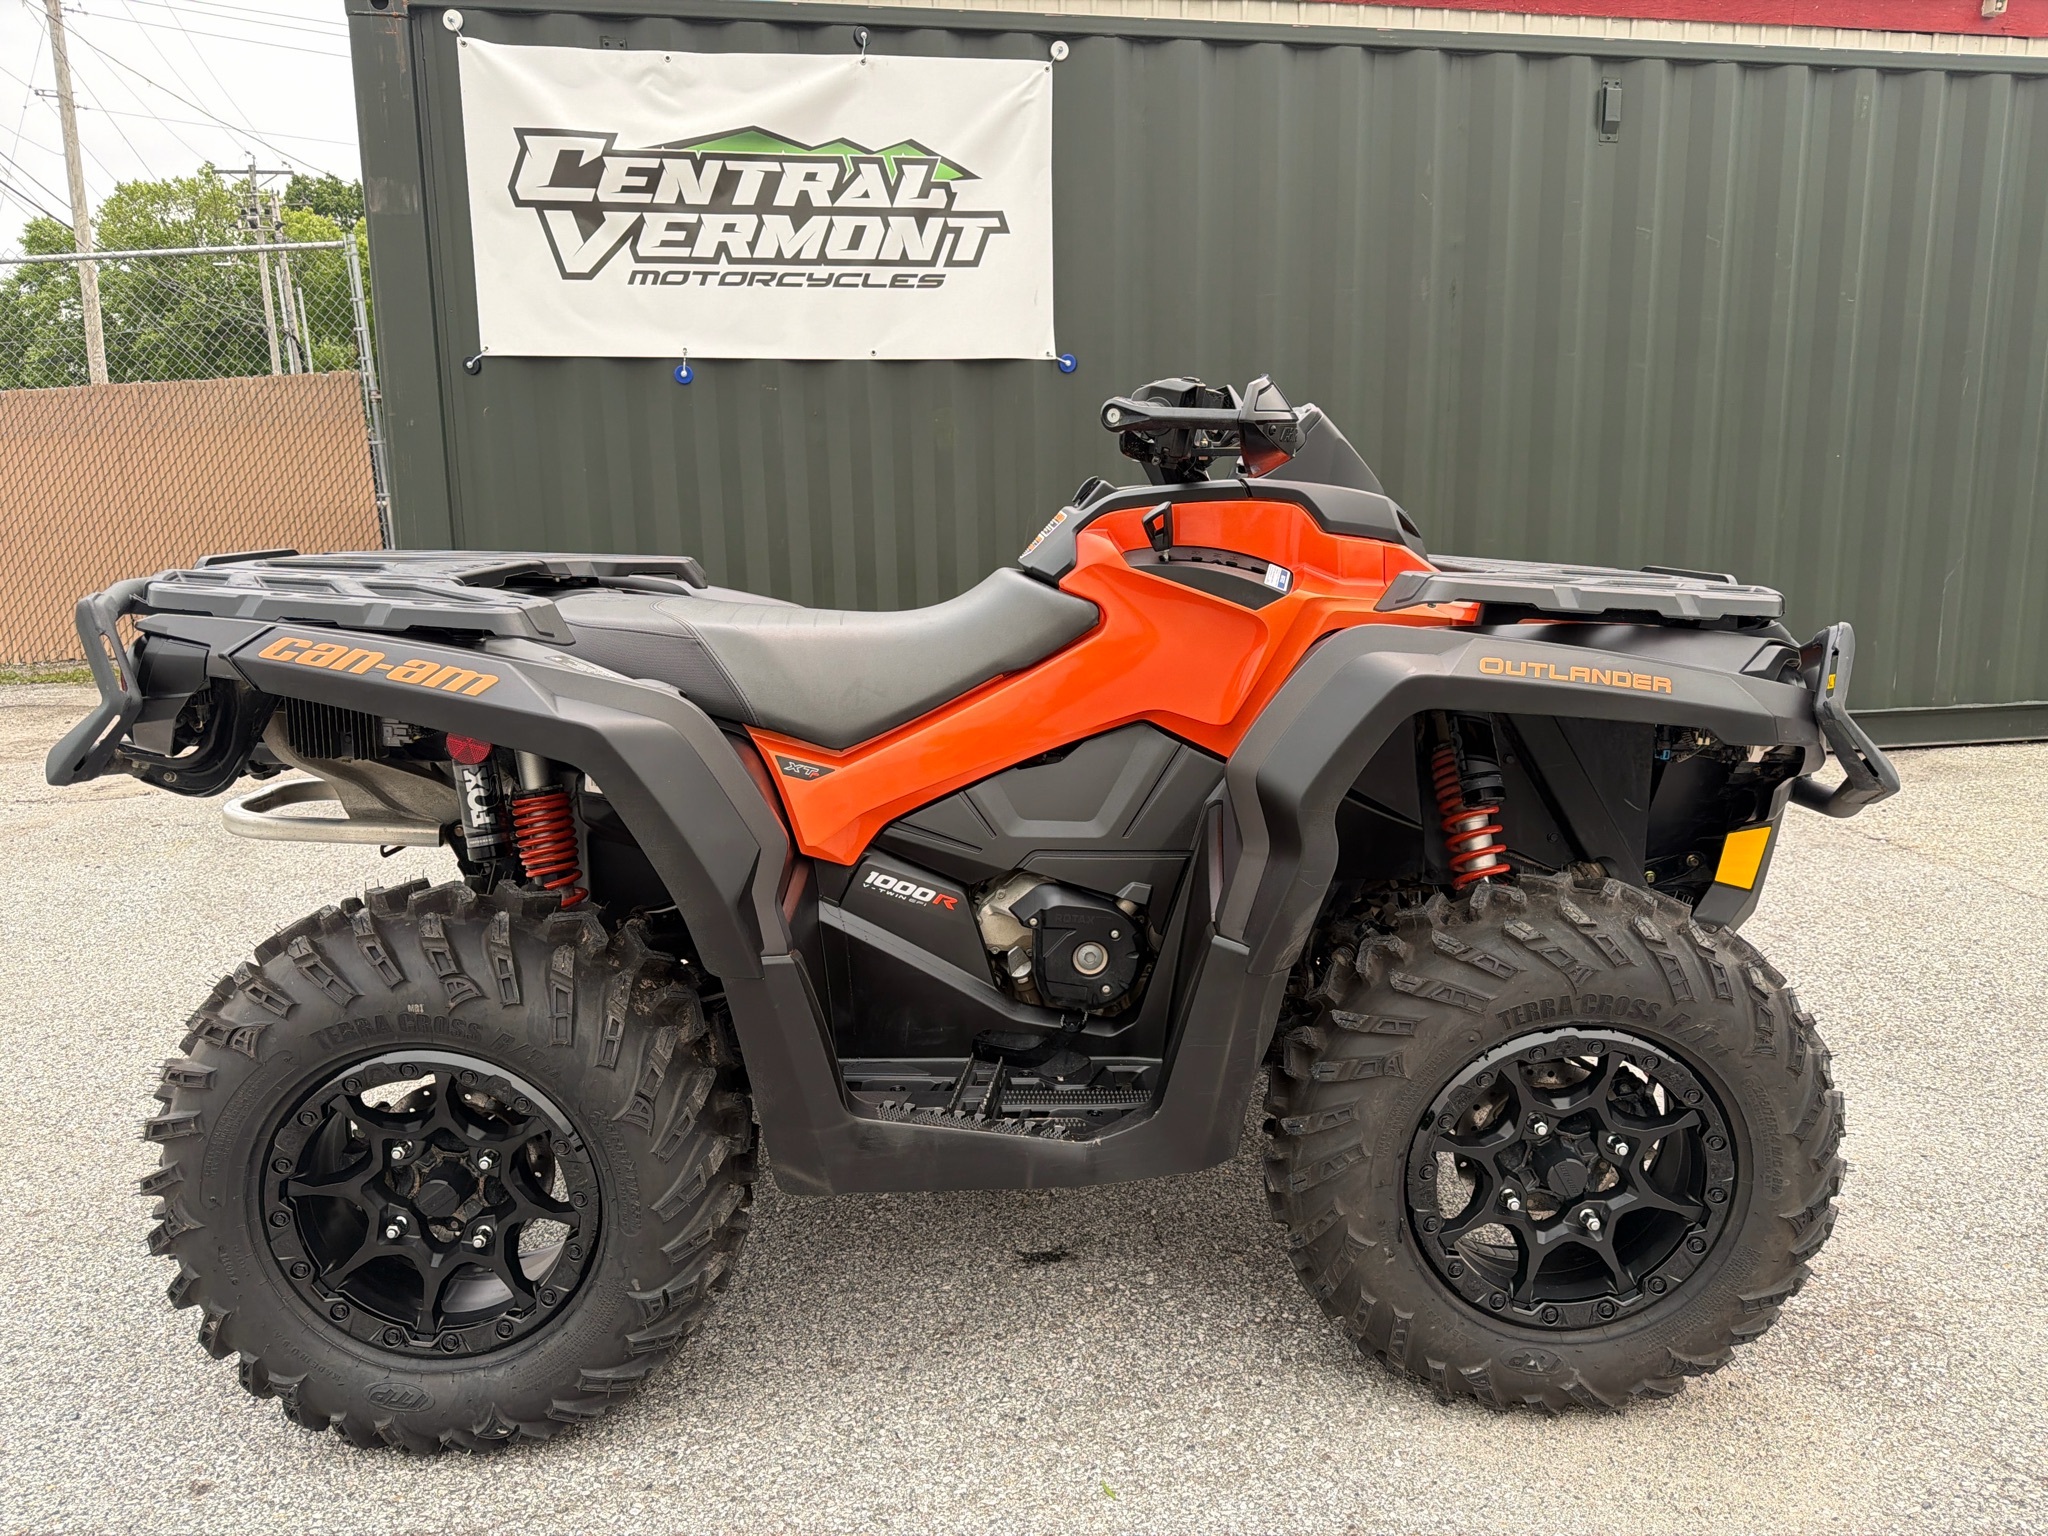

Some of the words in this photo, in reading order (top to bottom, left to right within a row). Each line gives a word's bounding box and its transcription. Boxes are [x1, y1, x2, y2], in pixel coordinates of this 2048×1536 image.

[513, 134, 948, 209] CENTRAL
[542, 209, 1001, 273] VERMONT
[627, 270, 947, 288] MOTORCYCLES
[1479, 657, 1672, 694] OUTLANDER
[462, 766, 498, 828] FOX
[862, 882, 907, 901] V-TWIN
[864, 870, 959, 911] 1000R
[1055, 913, 1096, 925] ROTAX
[309, 1013, 392, 1050] TERRA
[397, 1011, 484, 1043] CROSS
[1495, 995, 1574, 1031] TERRA
[1580, 993, 1661, 1023] CROSS
